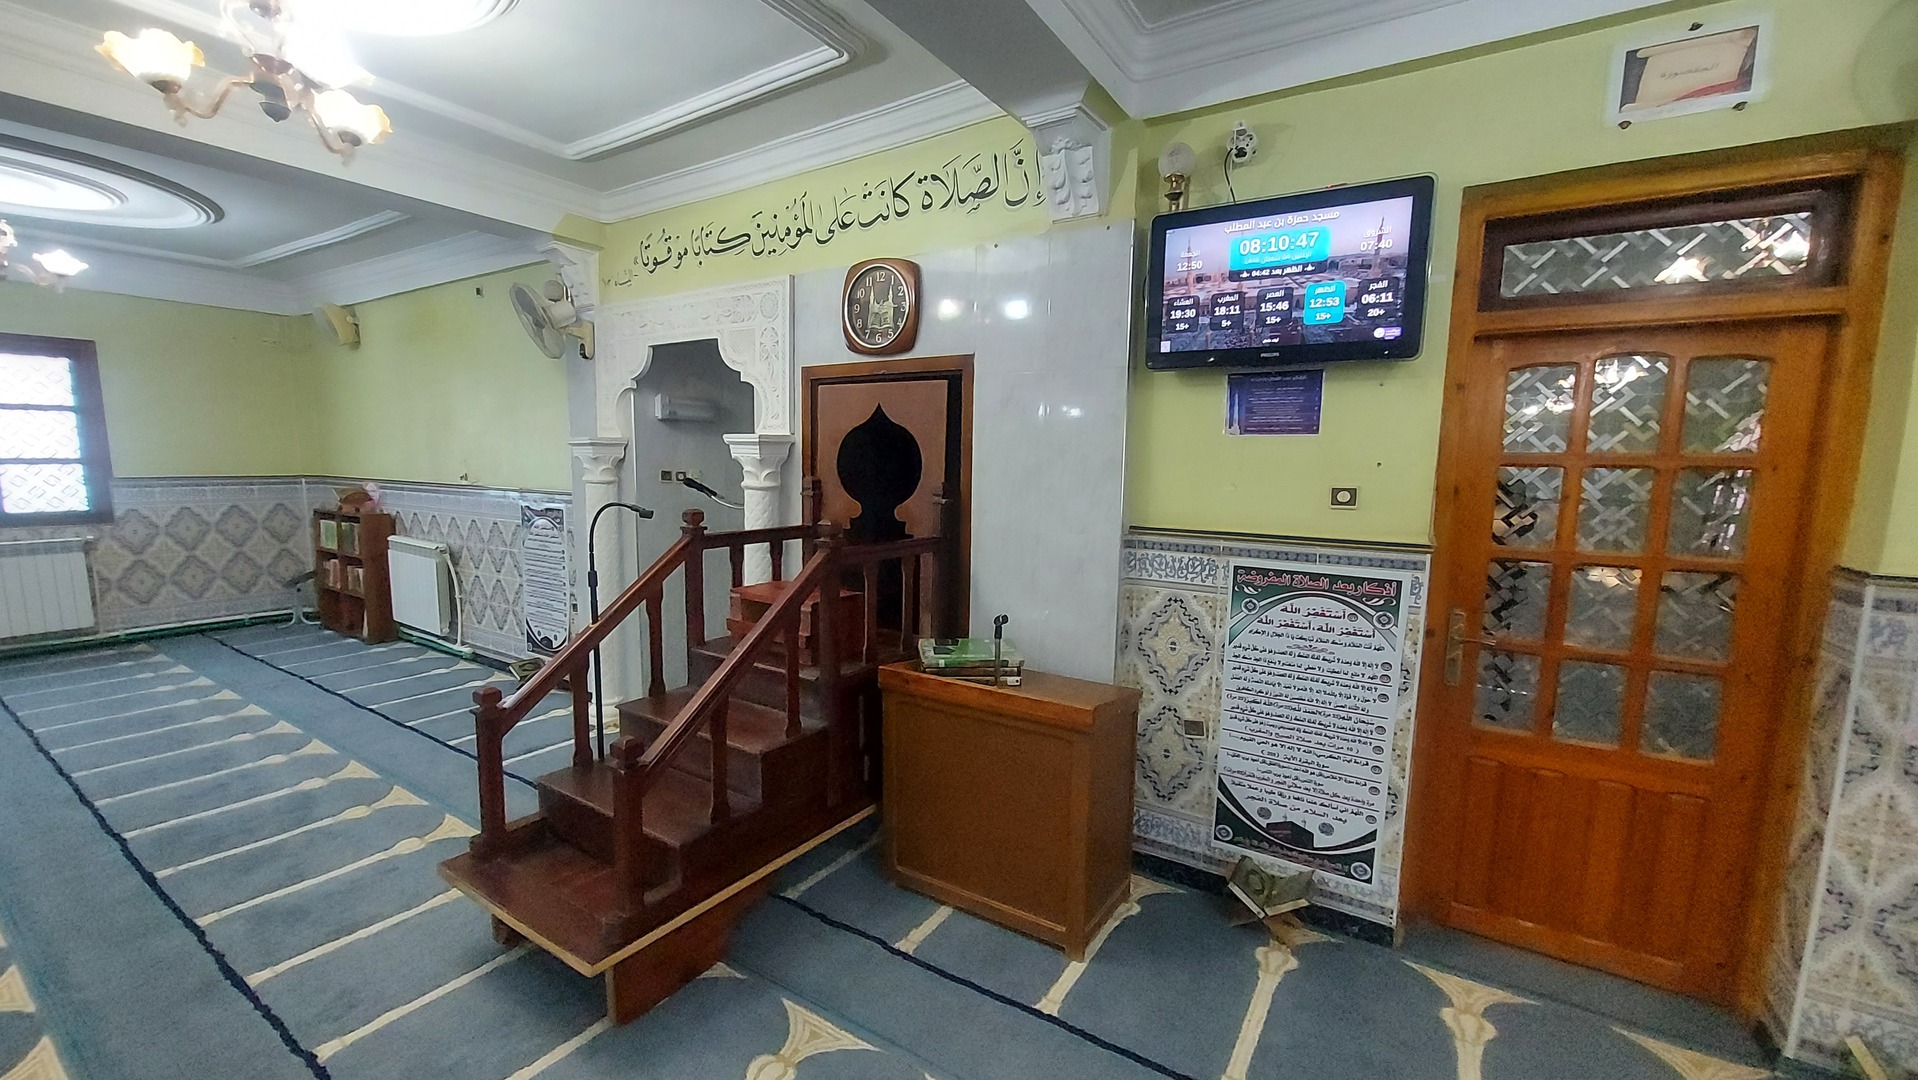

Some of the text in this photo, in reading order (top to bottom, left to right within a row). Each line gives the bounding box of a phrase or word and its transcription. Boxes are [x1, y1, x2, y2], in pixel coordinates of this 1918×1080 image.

[1224, 211, 1340, 234] مسجد حمزة بن عبد المطلب
[1239, 231, 1320, 255] 08:10:47
[1360, 239, 1393, 251] 07:40
[1176, 260, 1203, 272] 12:50
[876, 271, 886, 282] 12
[1251, 269, 1270, 277] 04:42
[866, 276, 873, 287] 11
[890, 275, 895, 285] 1
[856, 288, 865, 299] 10
[898, 286, 904, 296] 2
[1309, 297, 1340, 308] 12:53
[1361, 292, 1394, 304] 06:11
[854, 304, 860, 314] 9
[900, 302, 906, 312] 3
[1213, 305, 1241, 316] 18:11
[1260, 300, 1289, 312] 15:46
[1170, 309, 1196, 319] 19:30
[856, 319, 863, 329] 8
[864, 329, 870, 340] 7
[875, 332, 882, 343] 6
[887, 329, 894, 339] 5
[1236, 569, 1396, 599] أذكار بعد الصلاة المفروضة
